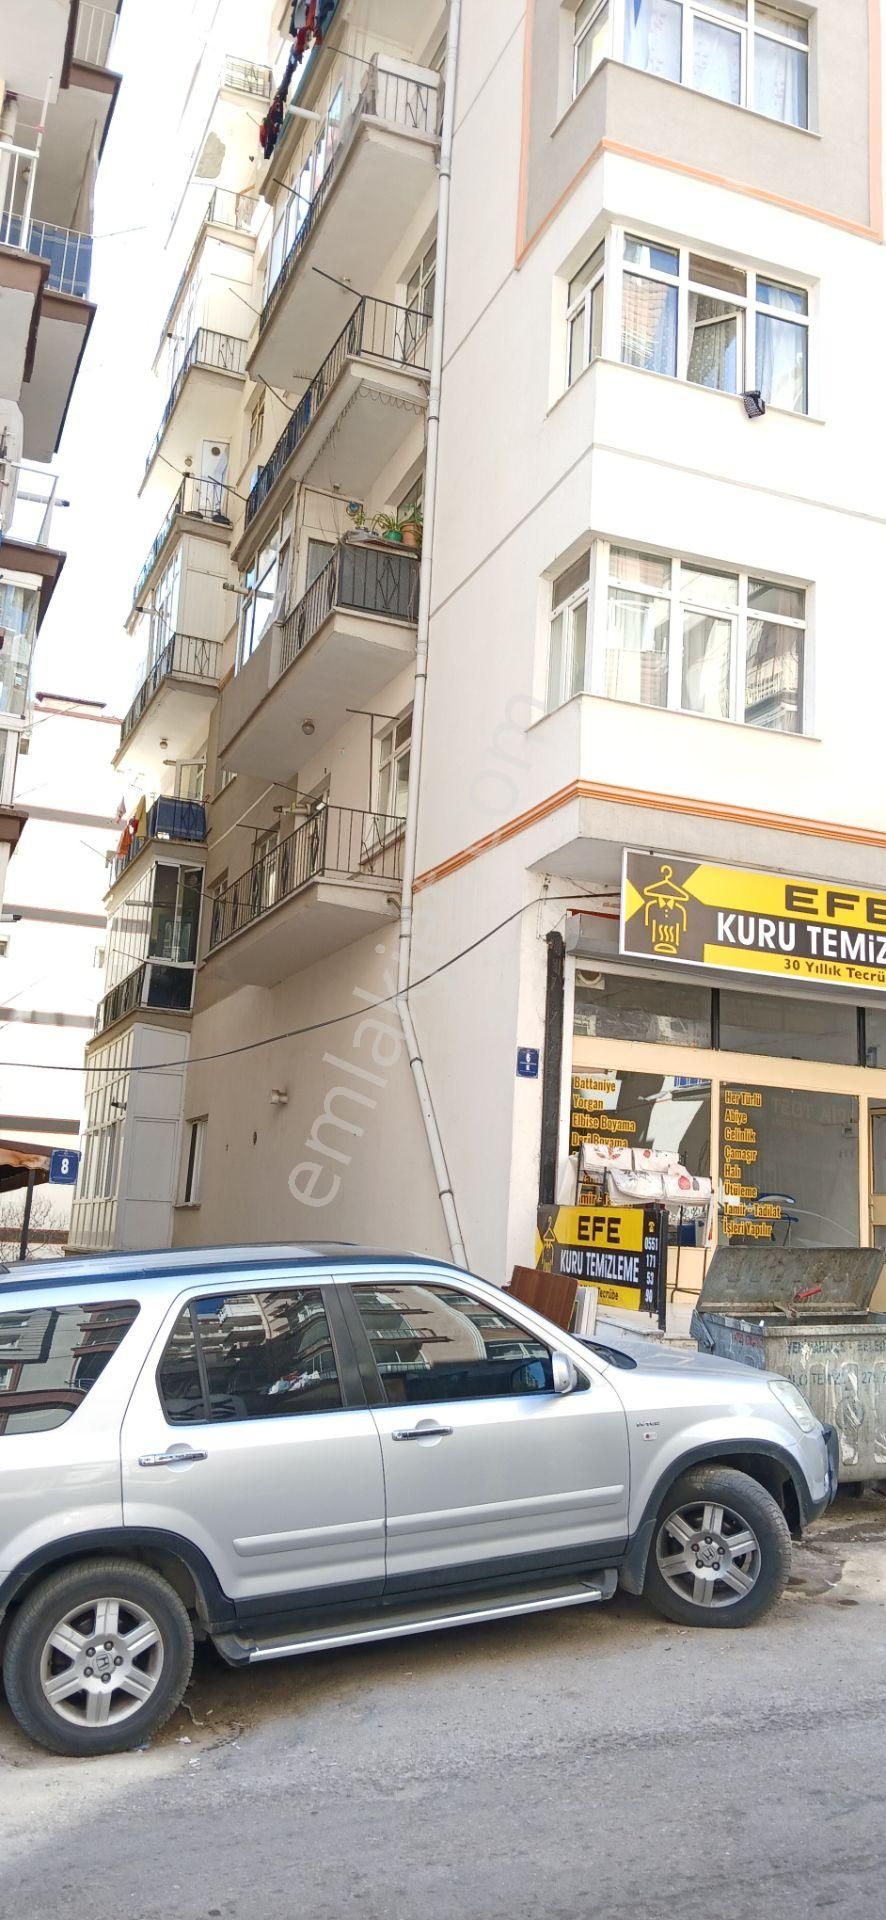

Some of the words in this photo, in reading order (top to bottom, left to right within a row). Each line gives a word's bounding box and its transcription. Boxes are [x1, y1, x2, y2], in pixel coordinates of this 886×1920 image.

[785, 884, 886, 925] EFE
[717, 912, 795, 951] KURU
[784, 958, 800, 970] 30
[806, 961, 840, 976] Yıllık
[846, 967, 885, 982] Tecrü
[573, 1077, 616, 1093] Battaniye
[573, 1094, 604, 1111] Yorgan
[725, 1090, 740, 1104] Her
[741, 1091, 762, 1107] Türlü
[572, 1113, 599, 1130] Elbise
[600, 1115, 636, 1133] Boyama
[725, 1108, 747, 1125] Abiye
[725, 1127, 756, 1142] Gelinlik
[724, 1145, 757, 1164] Çamaşır
[61, 1158, 69, 1174] 8
[724, 1164, 741, 1178] Halı
[724, 1180, 757, 1198] Ütüleme
[724, 1201, 746, 1216] Tamir
[754, 1203, 781, 1218] Tadilat
[578, 1216, 621, 1243] EFE
[723, 1216, 744, 1238] İşleri
[745, 1221, 772, 1239] Yapılır
[560, 1249, 583, 1275] KURU
